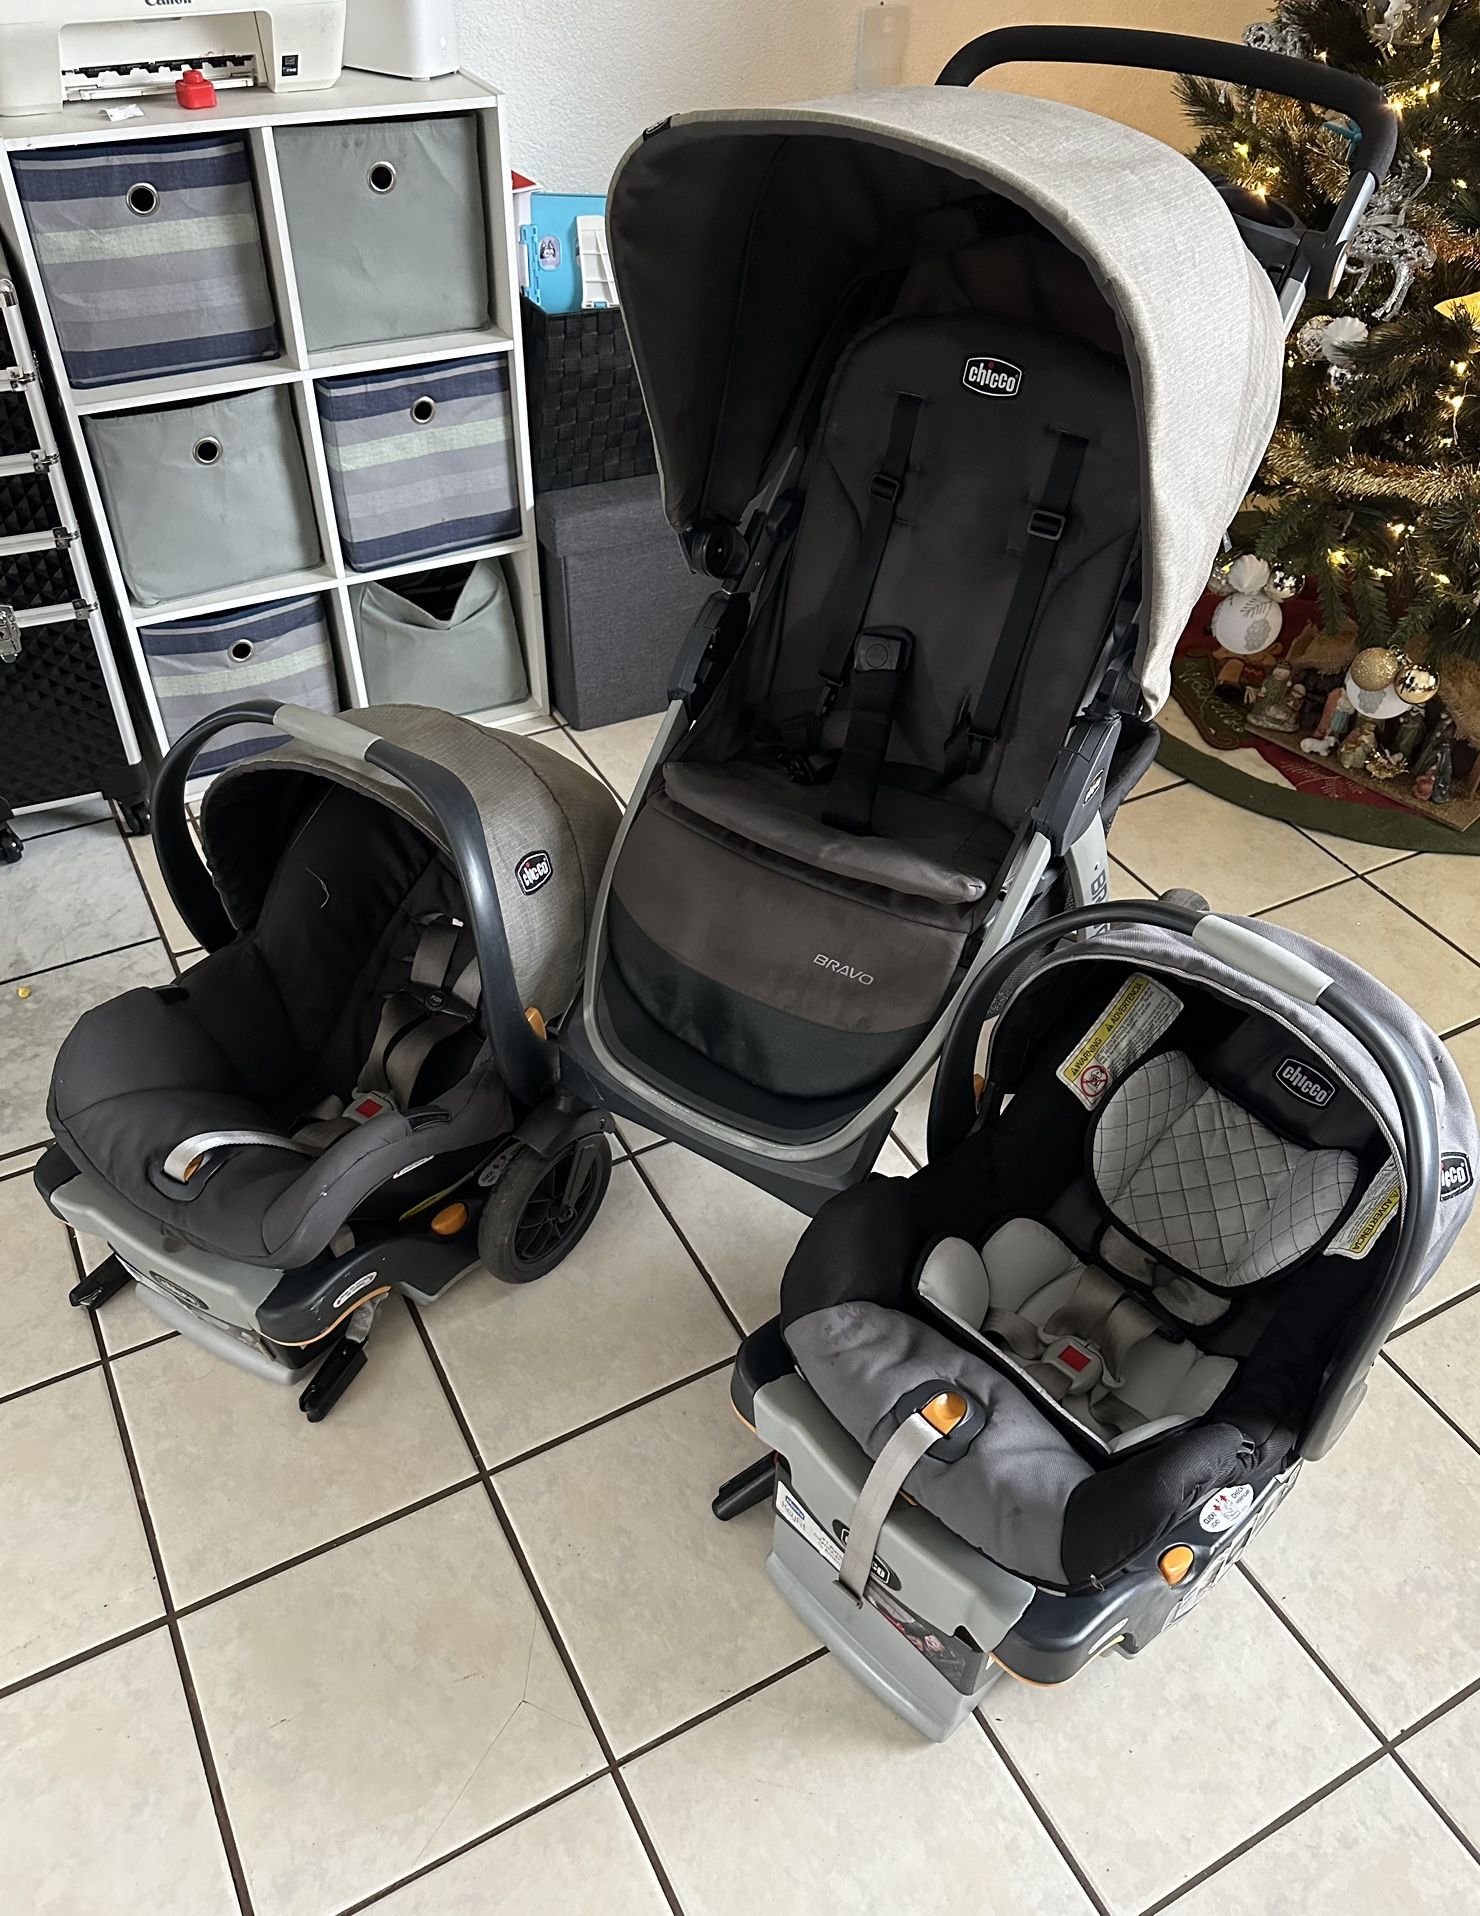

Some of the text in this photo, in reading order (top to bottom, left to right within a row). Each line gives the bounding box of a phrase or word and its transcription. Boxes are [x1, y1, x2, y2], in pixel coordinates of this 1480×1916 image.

[968, 361, 1017, 393] chicco
[813, 954, 874, 985] BRAVO
[1111, 983, 1142, 1024] ADVERTENCIA
[1074, 1038, 1101, 1068] WARNING
[1282, 1066, 1328, 1103] chicco
[1441, 1161, 1466, 1188] icco
[1352, 1198, 1393, 1250] ADVERTENCIA
